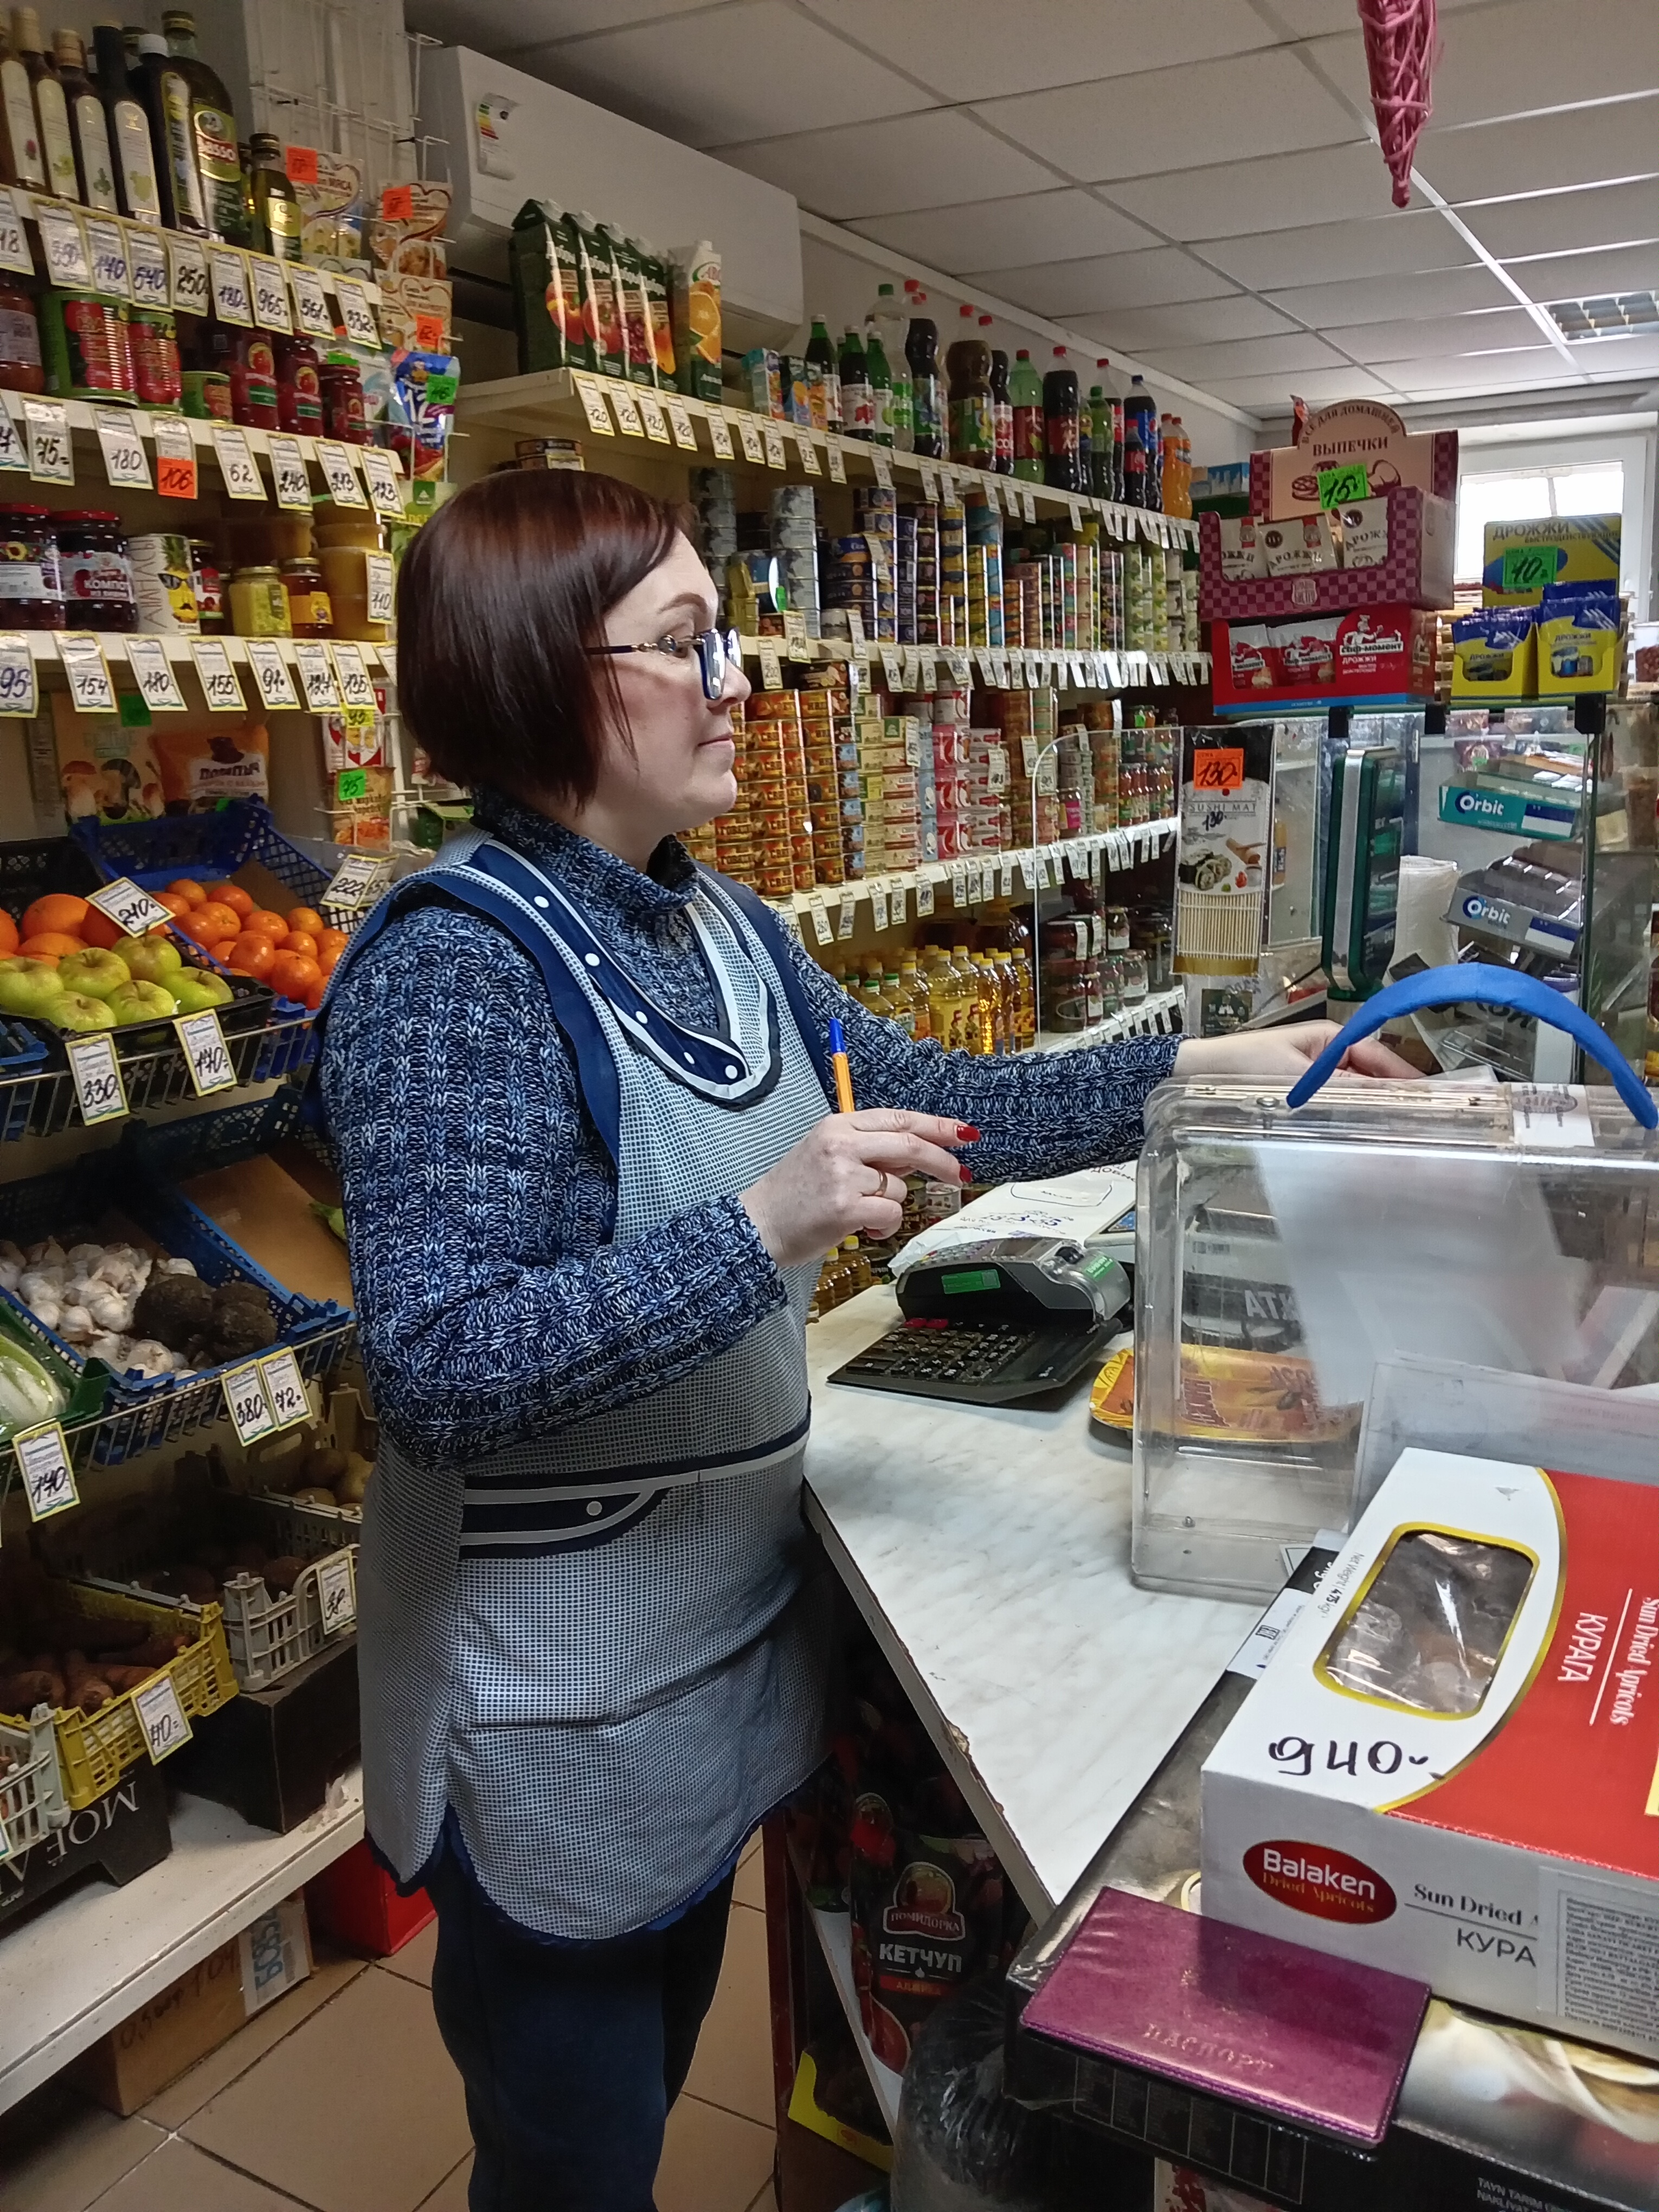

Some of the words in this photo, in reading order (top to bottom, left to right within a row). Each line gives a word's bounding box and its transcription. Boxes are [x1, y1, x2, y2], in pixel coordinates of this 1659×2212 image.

[1313, 436, 1388, 456] ВЫПЕЧКИ
[1493, 522, 1569, 541] ДРОЖЖИ
[1342, 655, 1377, 665] ДРОЖЖИ
[1187, 803, 1226, 812] SUSHI
[1459, 794, 1505, 816] Orbit
[1467, 899, 1512, 924] Orbit
[1557, 1611, 1608, 1683] КУРАГА
[1626, 1621, 1659, 1667] Dried
[1609, 1667, 1649, 1727] Apricots
[1263, 1847, 1375, 1900] Balaken
[1262, 1871, 1306, 1895] Dried
[1312, 1886, 1375, 1914] Apricots
[1414, 1882, 1455, 1909] Sun
[1460, 1895, 1522, 1926] Dried
[891, 1910, 960, 1933] ПОМИДОРКА
[879, 1942, 962, 1973] КЕТЧУП
